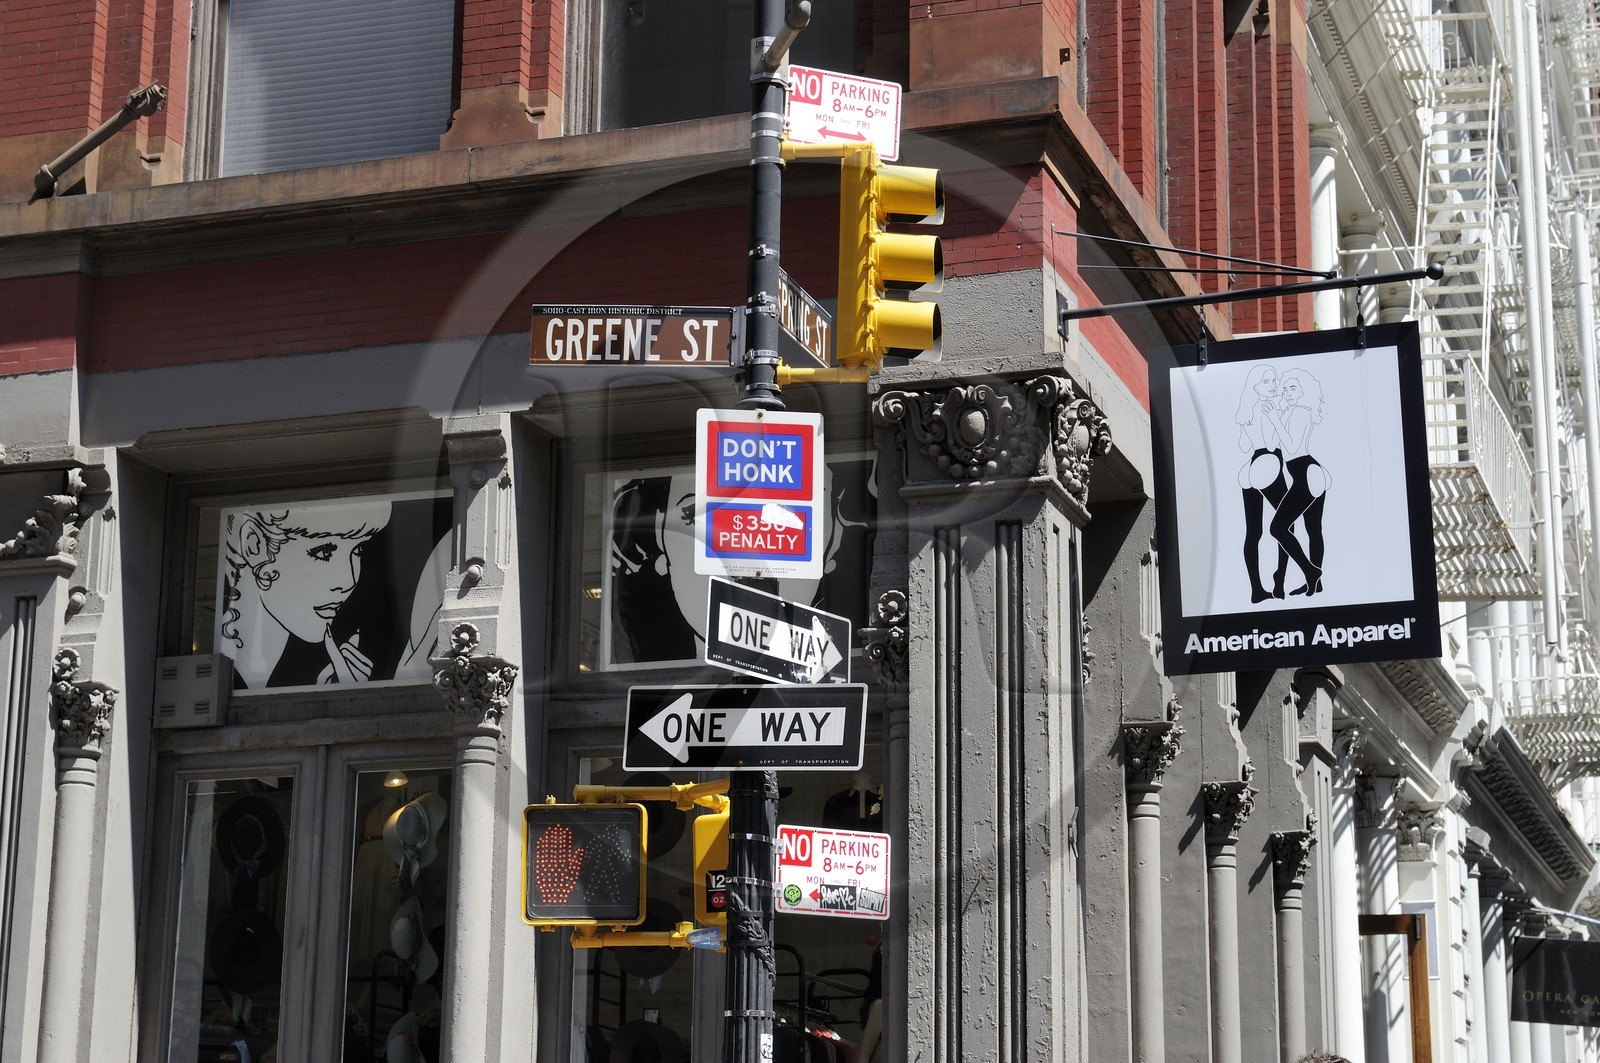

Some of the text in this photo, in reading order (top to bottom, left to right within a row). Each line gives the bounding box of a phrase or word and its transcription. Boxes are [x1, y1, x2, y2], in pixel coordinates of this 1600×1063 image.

[791, 71, 890, 105] NO PARKING
[815, 113, 834, 123] MON
[856, 120, 871, 129] FRI
[587, 307, 608, 315] IRON
[646, 308, 684, 316] DISTRICT
[545, 317, 719, 362] GREENE ST
[815, 315, 828, 362] ST
[722, 437, 797, 460] DON'T
[724, 462, 794, 485] HONK
[718, 531, 799, 551] PENALTY
[730, 611, 830, 663] ONE WAY
[1184, 628, 1305, 654] American
[712, 653, 723, 661] DEPT
[735, 659, 769, 673] TRANSPORTATION
[662, 711, 832, 743] ONE WAY
[781, 832, 880, 862] NO PARKING
[806, 876, 825, 885] MON
[847, 879, 861, 888] FRI
[1522, 990, 1573, 1002] OPERA
